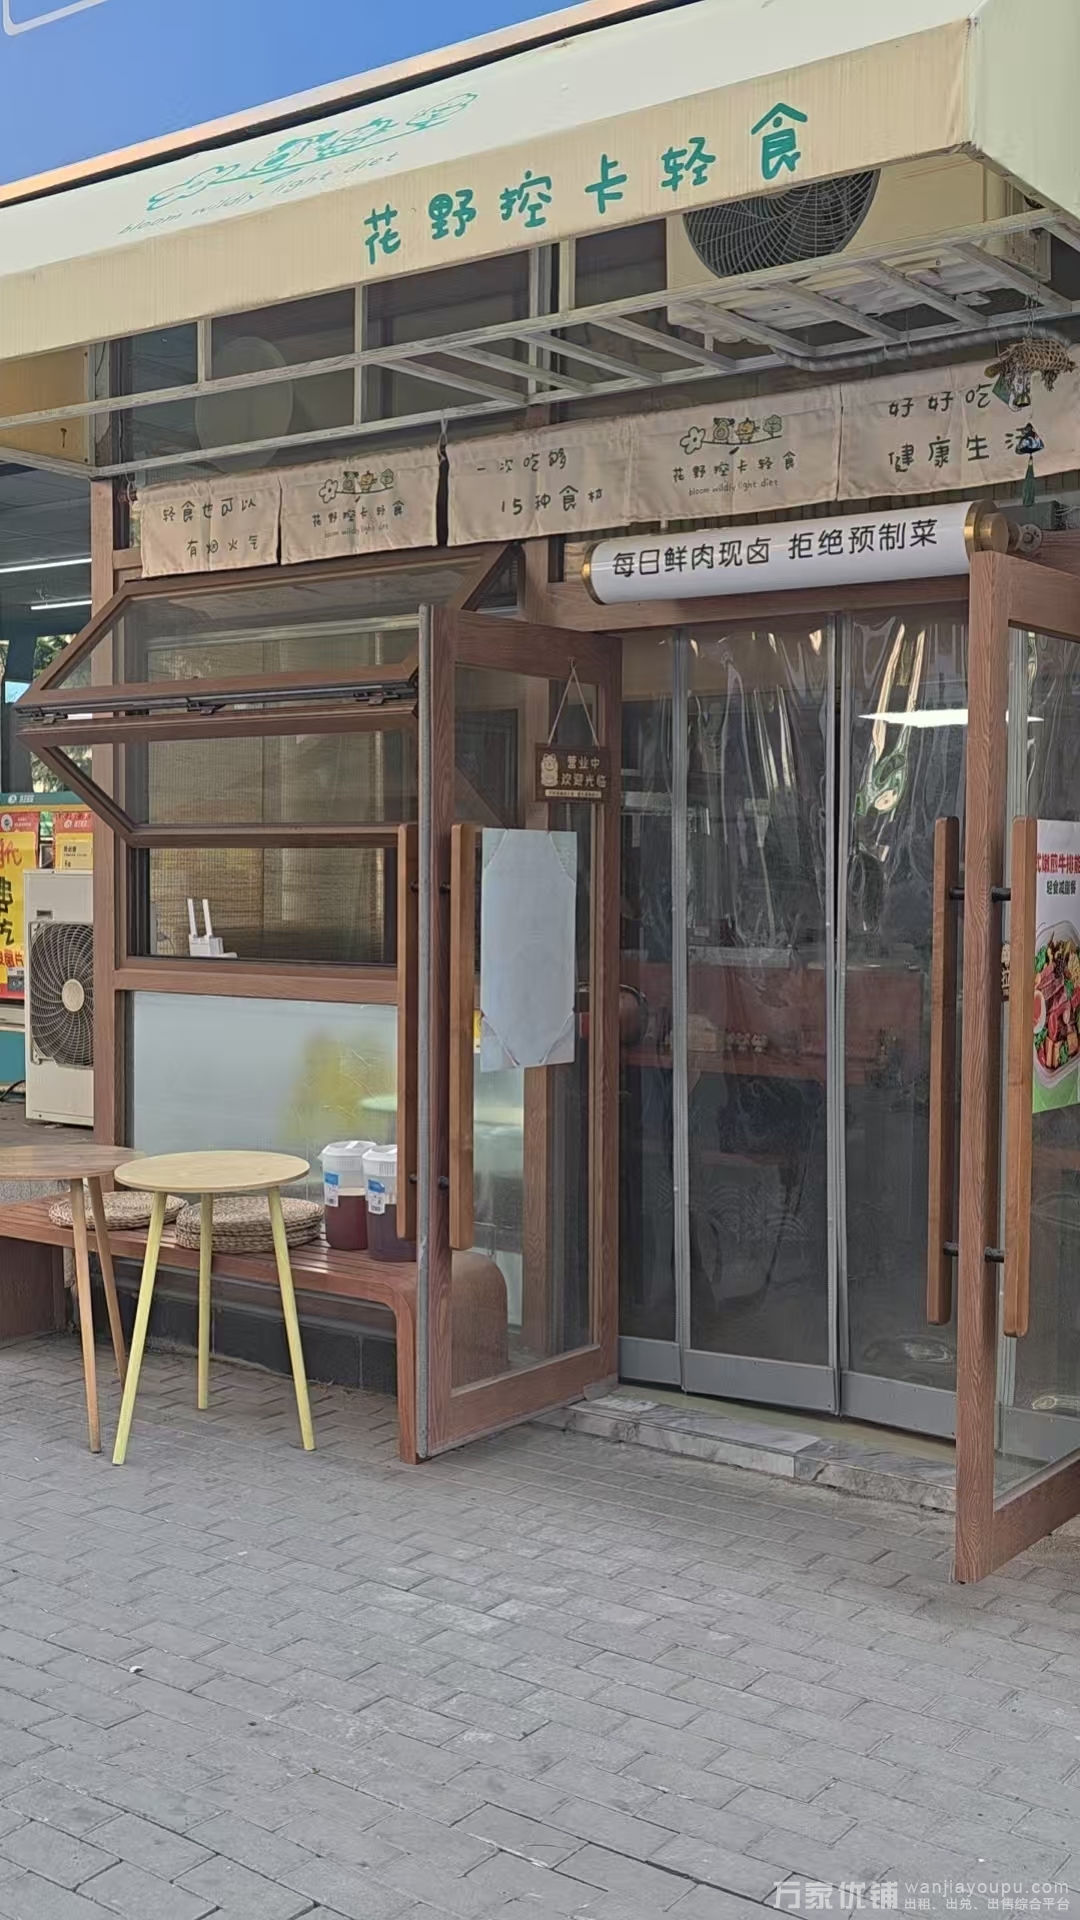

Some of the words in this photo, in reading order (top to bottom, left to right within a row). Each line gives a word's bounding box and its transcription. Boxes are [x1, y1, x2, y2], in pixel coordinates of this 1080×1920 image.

[271, 168, 333, 195] light
[344, 151, 399, 174] diet
[363, 102, 808, 265] 花野控卡轻食
[476, 447, 567, 473] 一次吃够
[673, 450, 796, 482] 花野控卡轻食
[760, 477, 778, 487] diet
[162, 497, 257, 522] 轻食也可以
[187, 535, 258, 558] 有烟火气
[611, 537, 772, 577] 每日鲜肉现卤
[788, 518, 939, 560] 拒绝预制菜
[567, 754, 600, 770] 营业中
[560, 772, 607, 788] 欢迎光临
[1046, 879, 1077, 895] 轻食减脂餐
